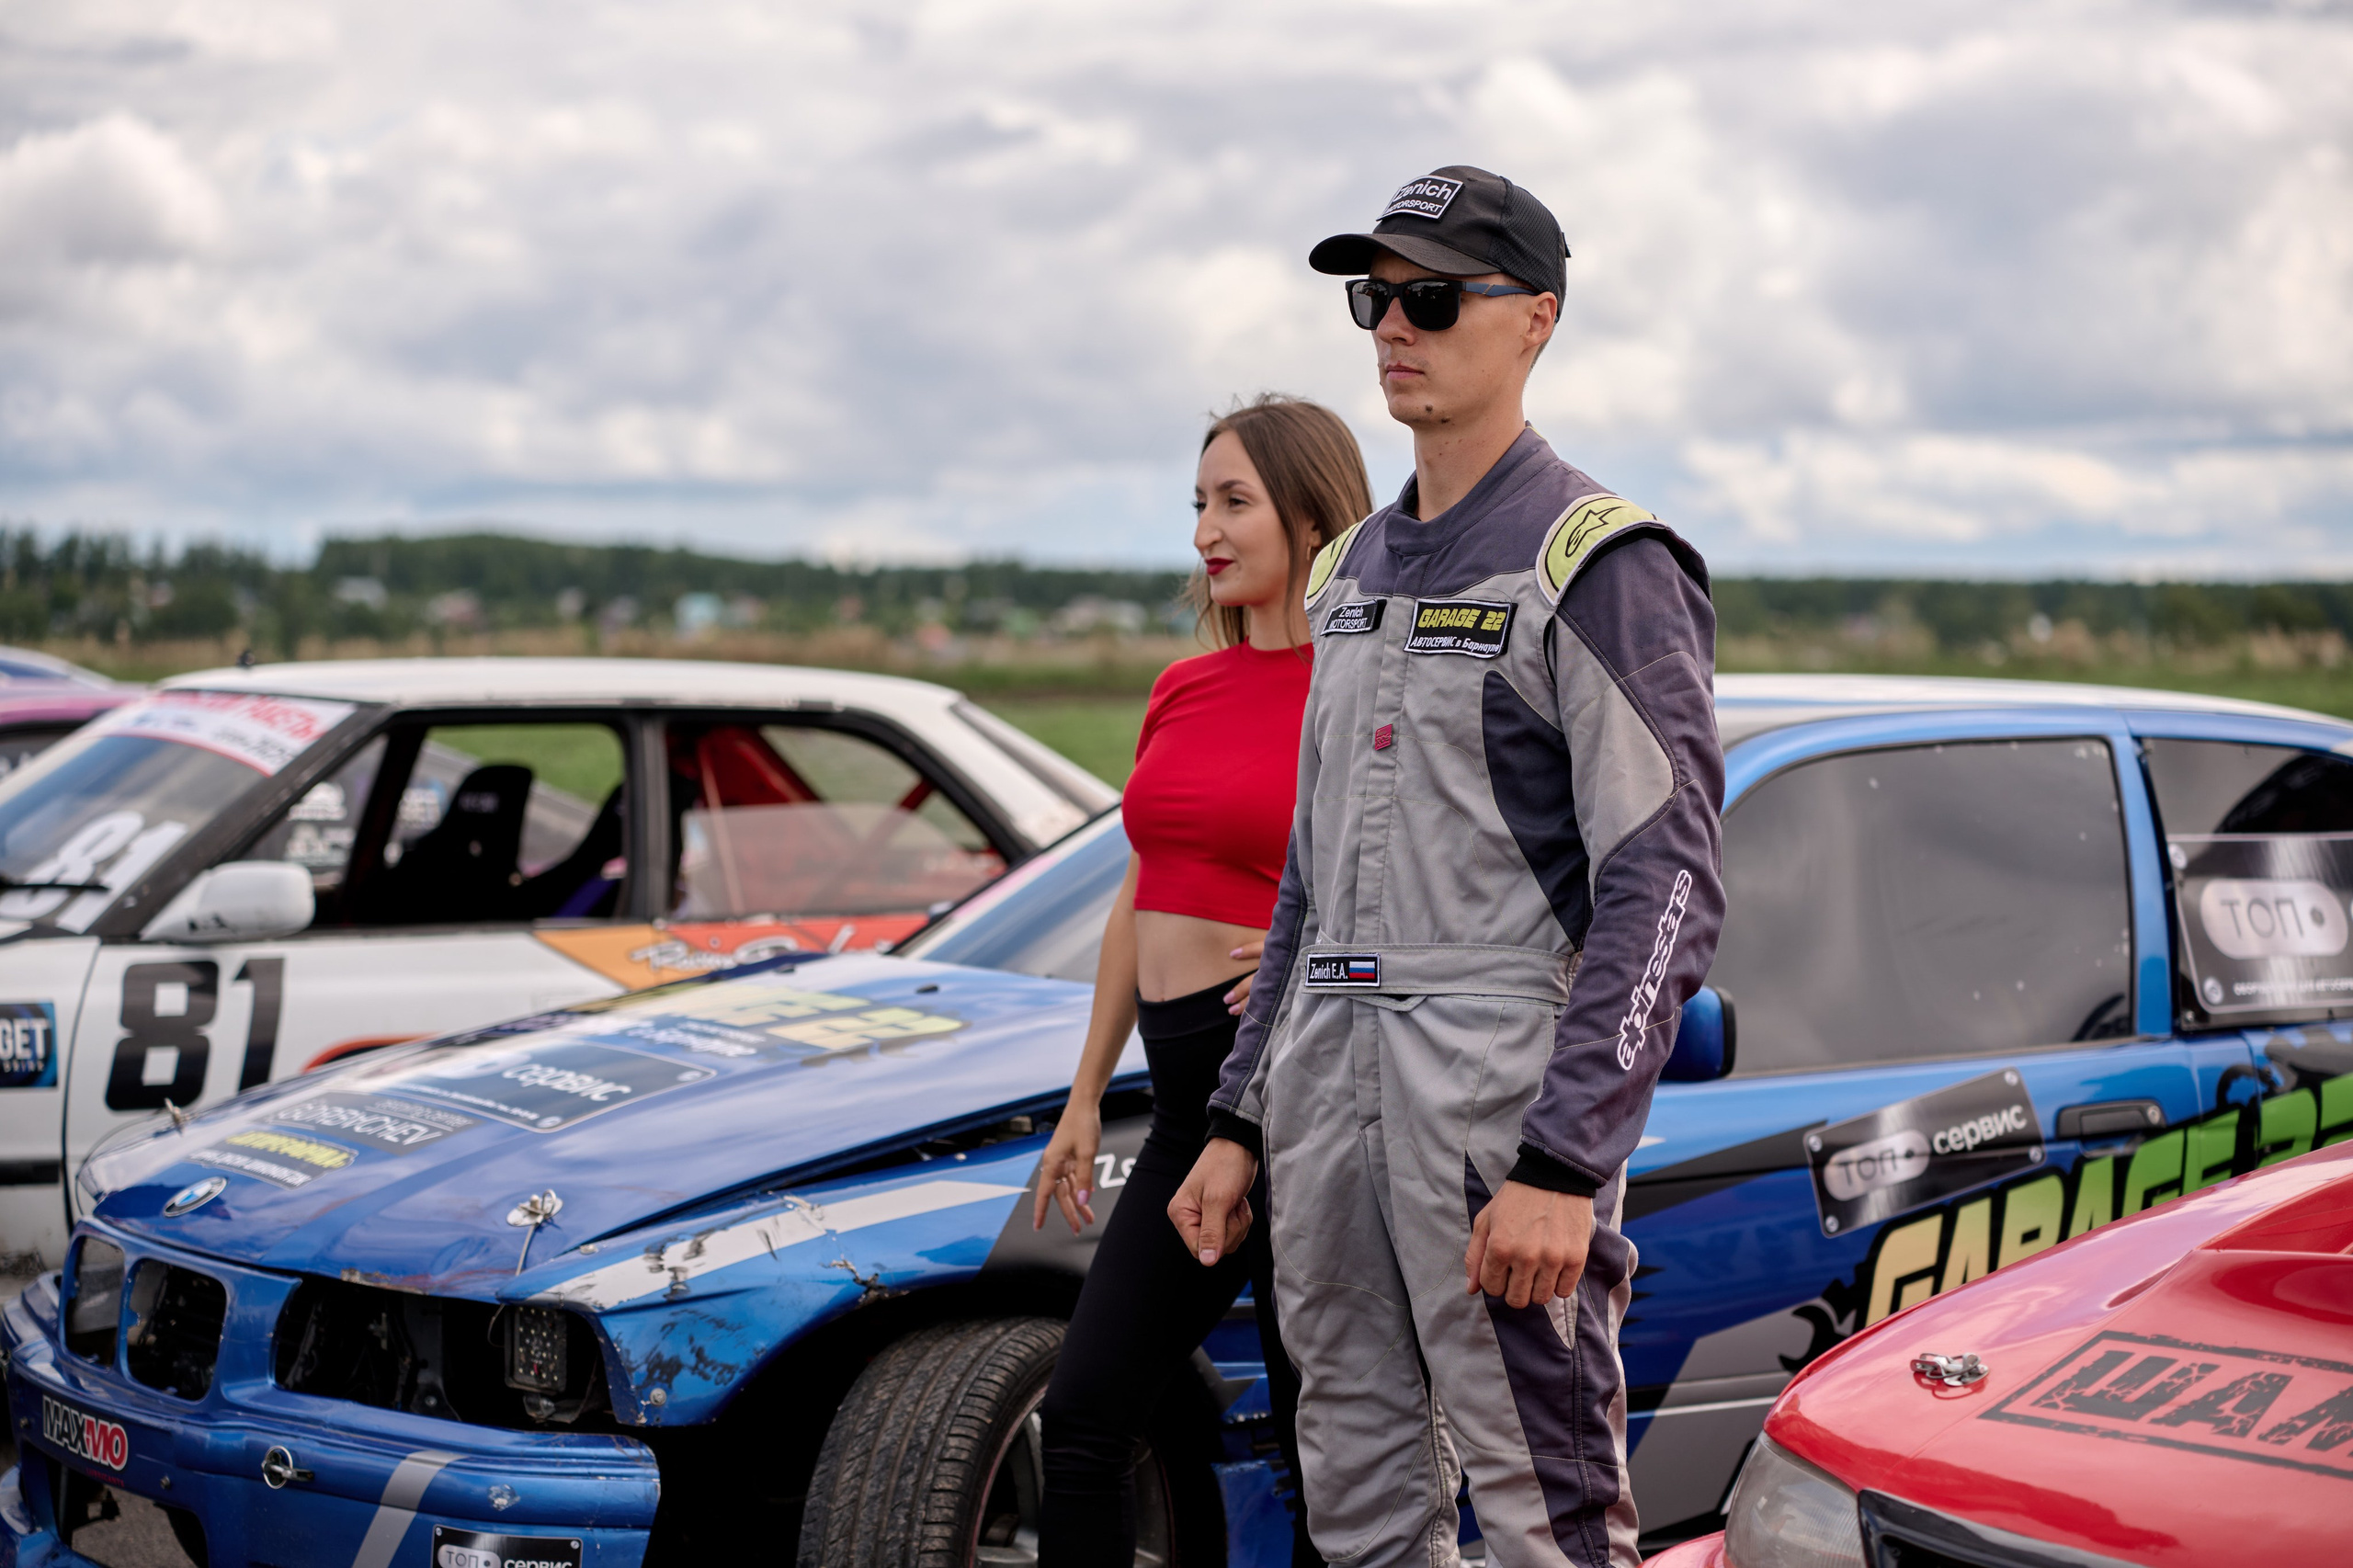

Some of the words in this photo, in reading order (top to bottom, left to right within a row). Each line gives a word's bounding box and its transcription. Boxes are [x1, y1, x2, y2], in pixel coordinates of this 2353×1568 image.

[1339, 606, 1364, 618] Zenich
[1417, 608, 1482, 629] GARAGE
[1480, 610, 1506, 631] 22
[1410, 636, 1457, 648] АВТОСЕРВИС
[2219, 896, 2304, 939] ТОП
[1309, 961, 1331, 980] Zenich
[1331, 962, 1348, 980] E.A.
[1616, 869, 1693, 1072] alpinestars
[104, 957, 286, 1113] 81
[1839, 1148, 1898, 1187] ТОП
[1932, 1104, 2029, 1156] сервис
[446, 1551, 479, 1567] ТОП
